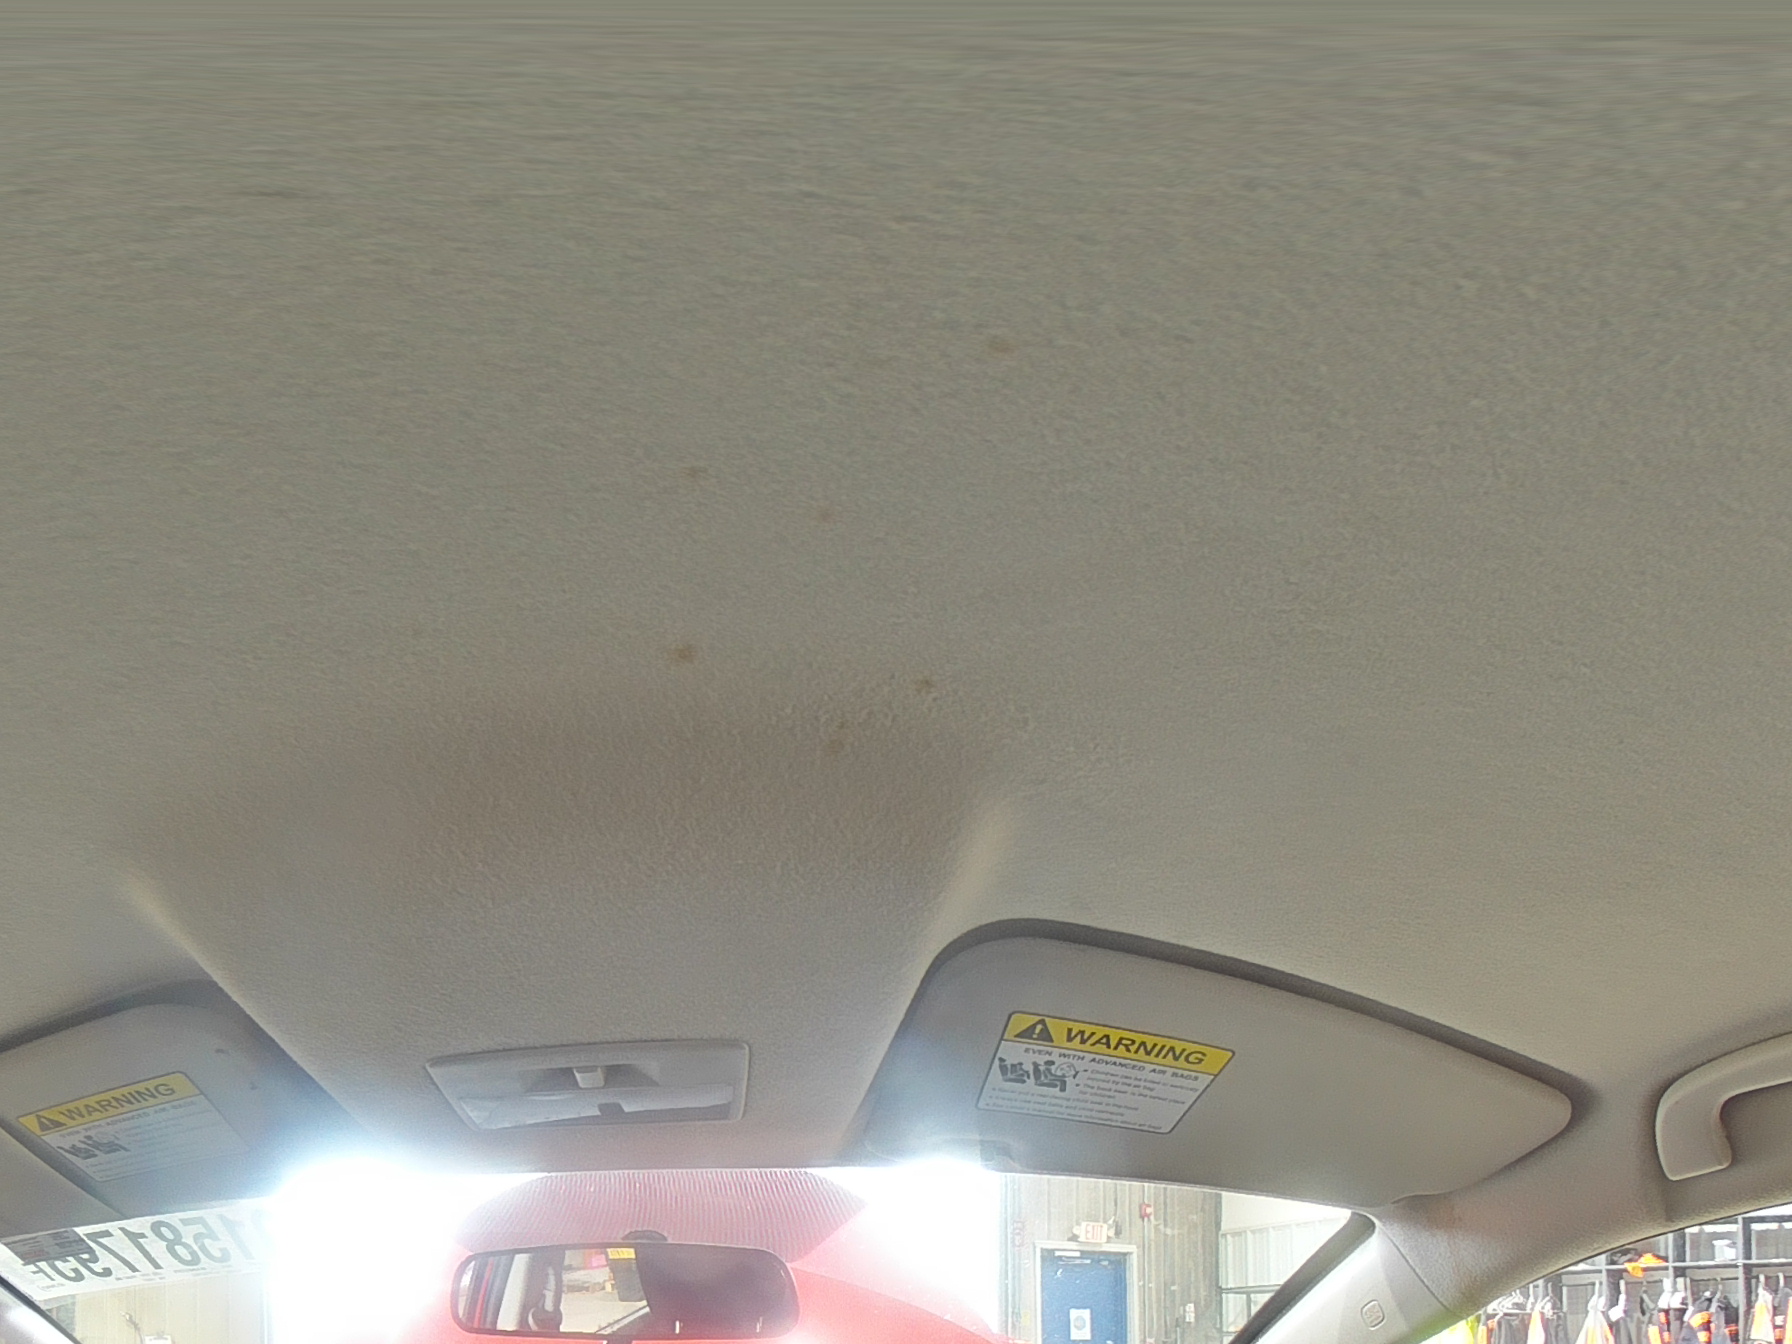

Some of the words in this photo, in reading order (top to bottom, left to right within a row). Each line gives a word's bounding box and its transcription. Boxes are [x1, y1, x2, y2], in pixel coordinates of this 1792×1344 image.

[1023, 1047, 1053, 1057] EVEN
[1058, 1051, 1085, 1062] WITH
[1088, 1056, 1146, 1071] ADVANCED
[1065, 1027, 1207, 1066] WARNING
[59, 1082, 176, 1123] WARNING
[1085, 1223, 1104, 1242] EXIT
